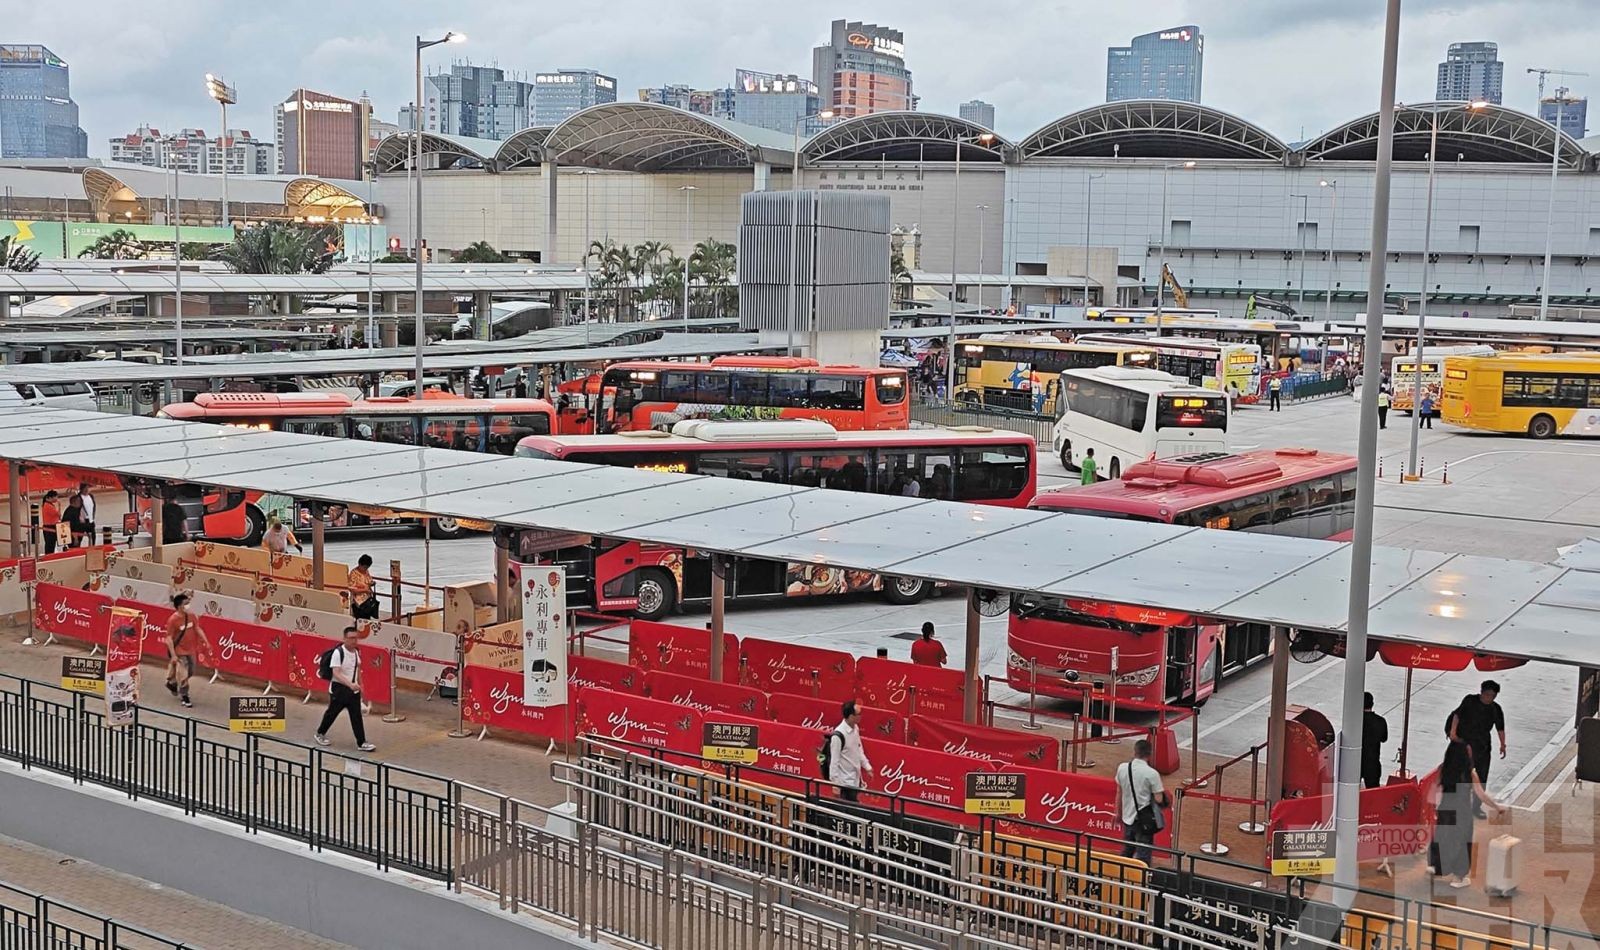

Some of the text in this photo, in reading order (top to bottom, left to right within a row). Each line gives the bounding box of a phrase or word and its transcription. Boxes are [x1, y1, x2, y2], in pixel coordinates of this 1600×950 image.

[54, 597, 91, 623] Wynn
[535, 584, 549, 652] 永利專車
[219, 632, 263, 659] Wynn
[239, 698, 277, 707] 澳門銀河
[608, 707, 668, 739] Wynn
[712, 725, 751, 736] 澳門銀河
[641, 735, 666, 747] 永利澳門
[773, 763, 800, 774] 永利澳門
[880, 760, 954, 794] Wynn
[975, 775, 1017, 785] 澳門銀河
[919, 791, 950, 804] 永利澳門
[1041, 787, 1116, 824] Wynn
[1283, 833, 1328, 844] 澳門銀河
